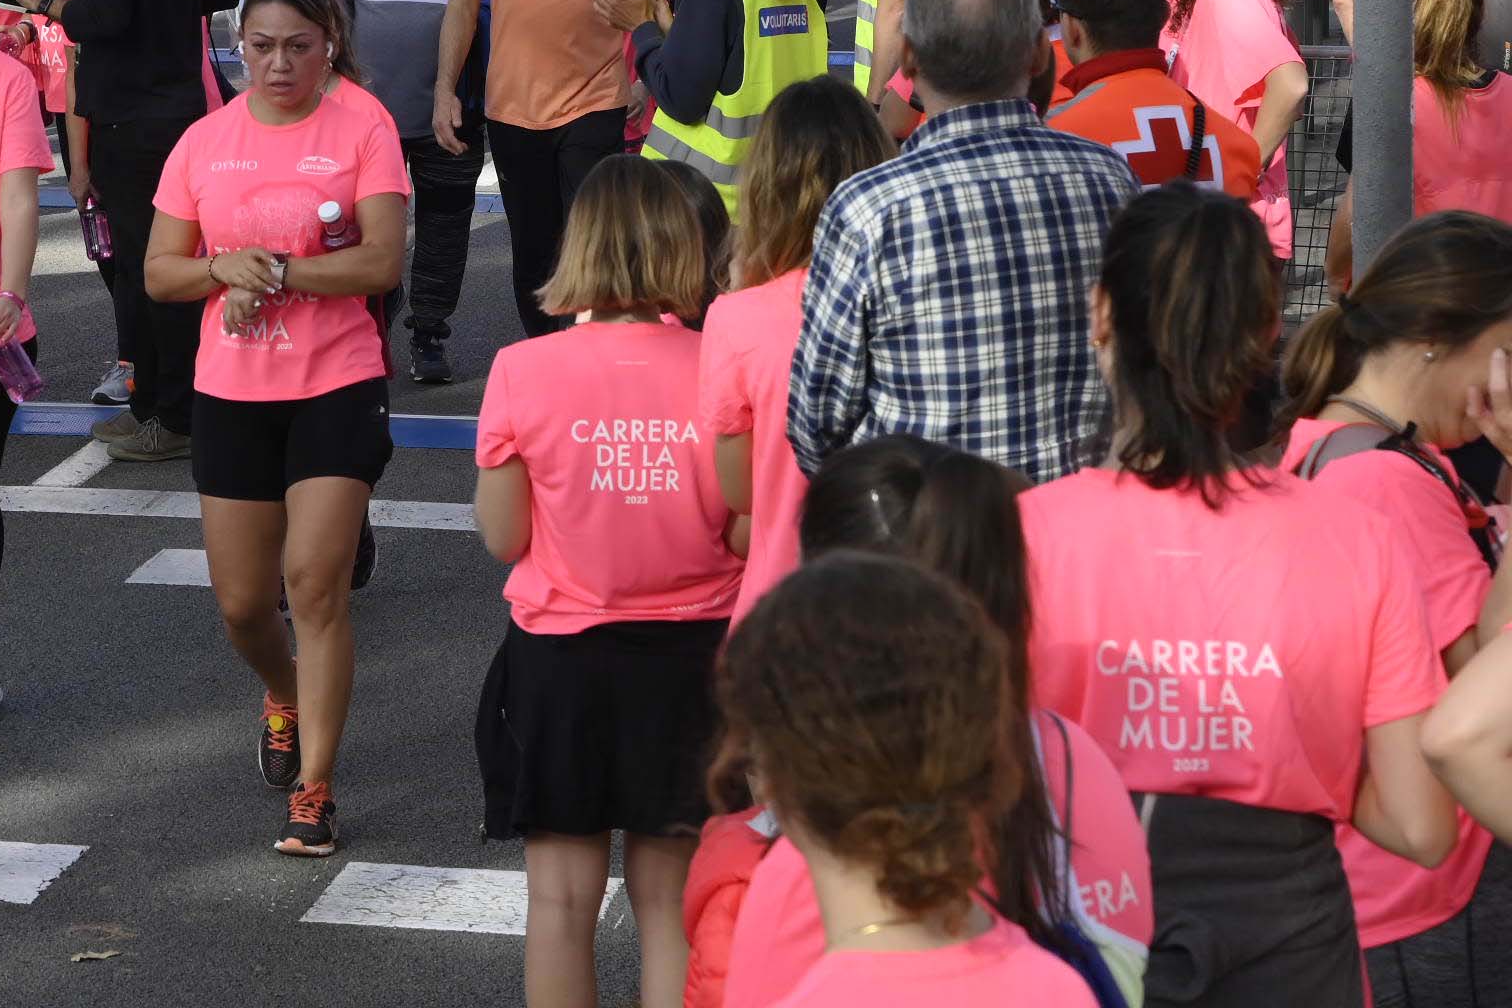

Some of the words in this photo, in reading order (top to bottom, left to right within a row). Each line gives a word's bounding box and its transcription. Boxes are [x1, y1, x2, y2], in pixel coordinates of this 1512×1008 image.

[211, 160, 258, 172] OYSHO
[570, 419, 700, 443] CARRERA
[596, 444, 633, 467] DE
[642, 444, 675, 467] LA
[590, 469, 680, 492] MUJER
[624, 495, 649, 505] 2023
[1096, 640, 1283, 679] CARRERA
[1128, 677, 1180, 713] DE
[1198, 679, 1245, 713] LA
[1119, 715, 1256, 752] MUJER
[1173, 758, 1210, 772] 2023
